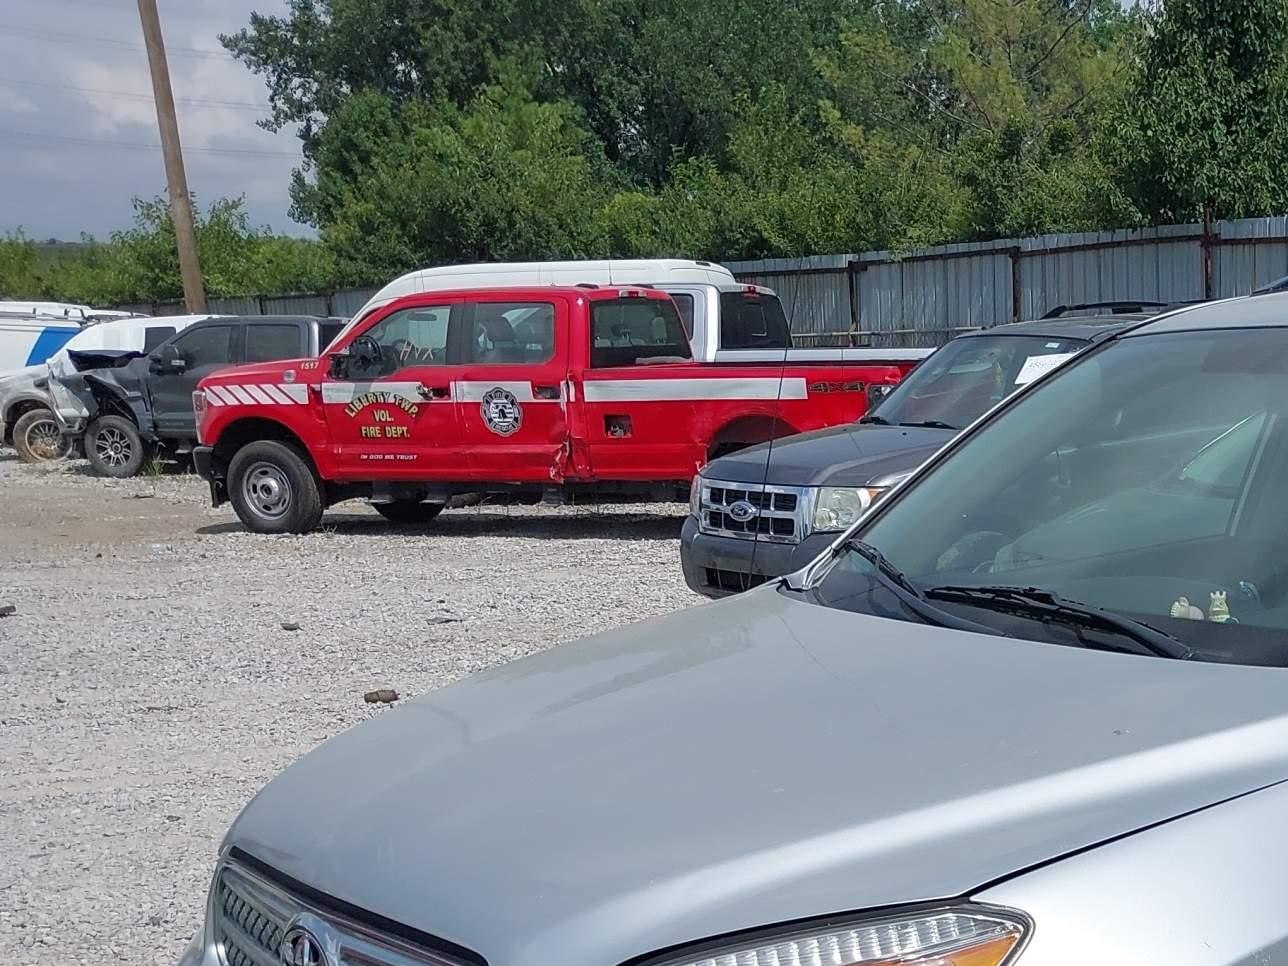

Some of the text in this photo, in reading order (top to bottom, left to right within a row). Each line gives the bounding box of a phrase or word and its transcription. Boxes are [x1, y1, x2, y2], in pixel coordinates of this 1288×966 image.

[344, 391, 419, 418] LIBERTY TWP.
[373, 409, 395, 422] VOL.
[361, 426, 411, 438] FIRE DEPT.
